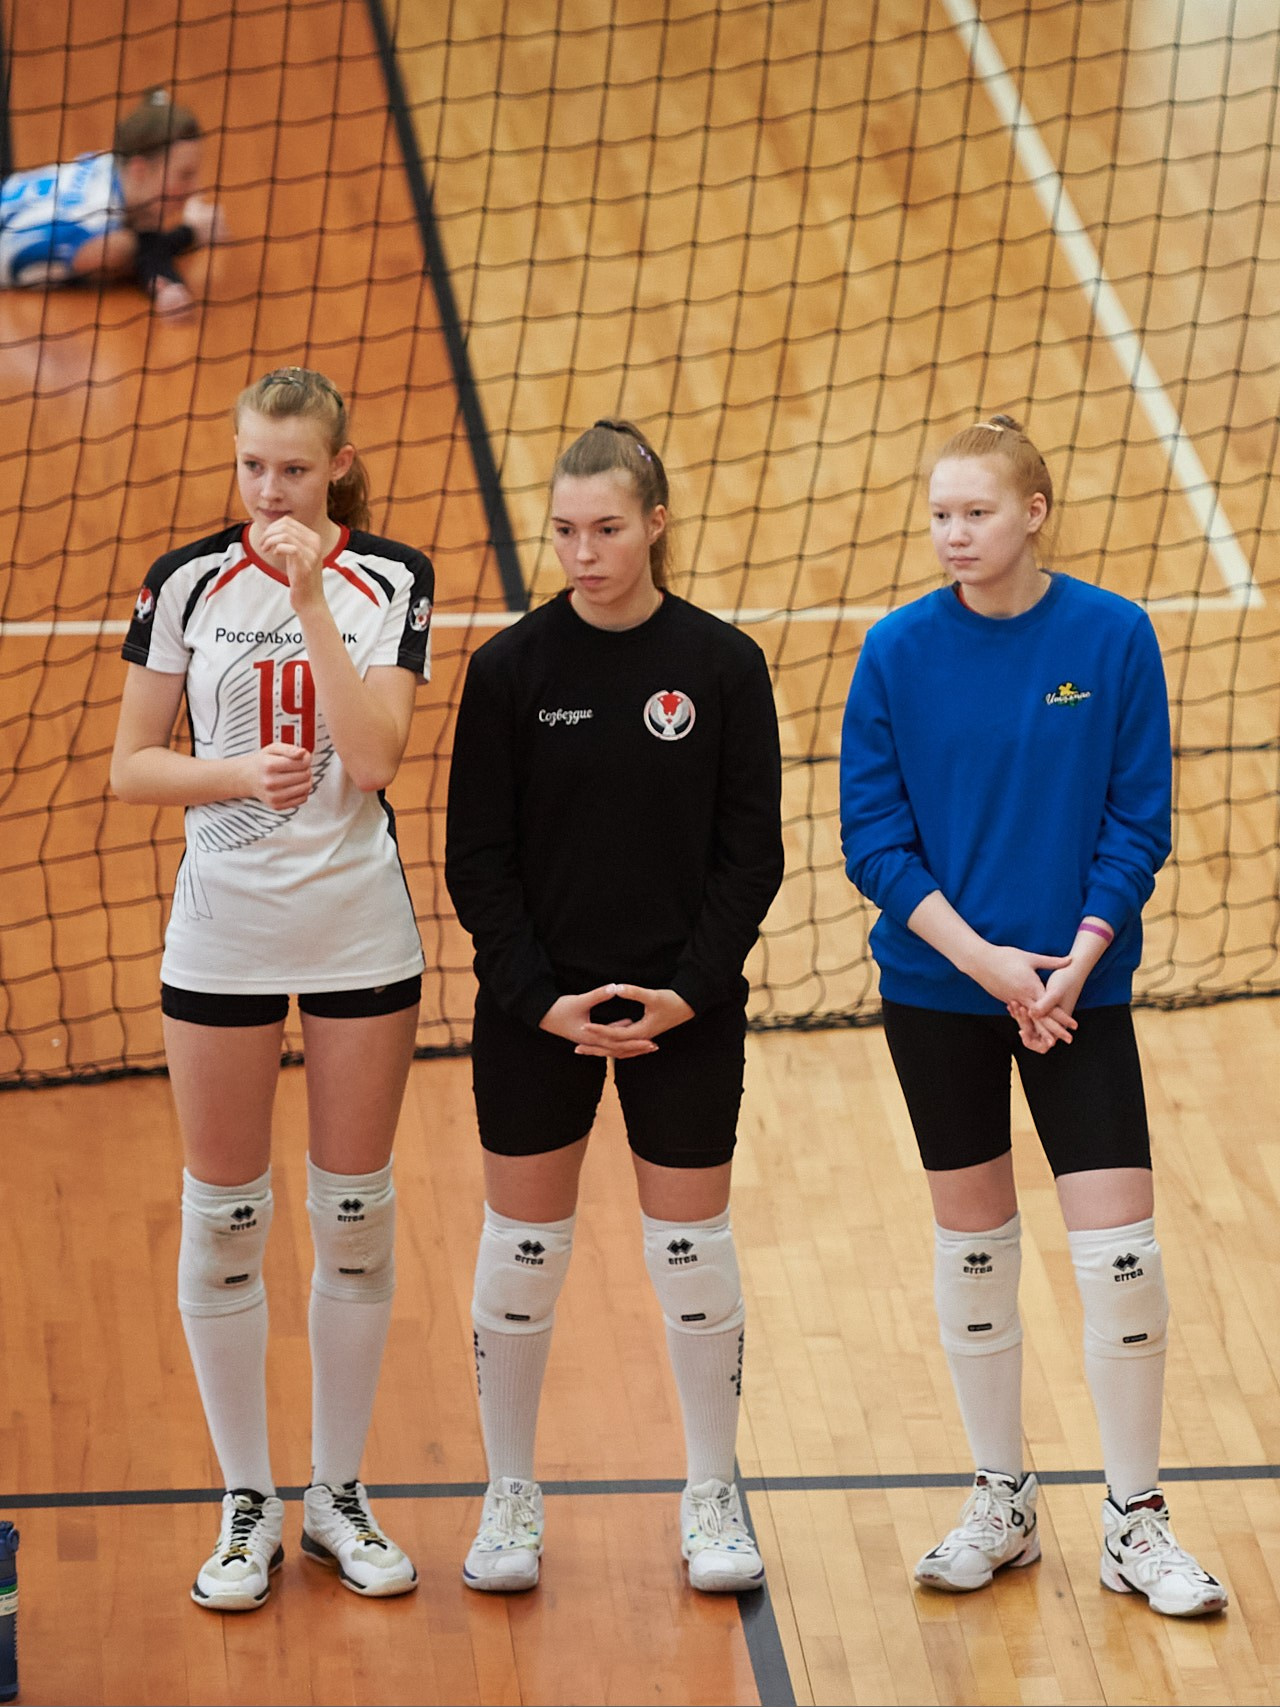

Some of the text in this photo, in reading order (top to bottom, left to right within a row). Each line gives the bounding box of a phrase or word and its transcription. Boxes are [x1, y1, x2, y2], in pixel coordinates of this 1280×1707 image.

[253, 659, 315, 752] 19
[668, 1253, 698, 1266] errea
[963, 1264, 993, 1275] errea
[1114, 1268, 1144, 1283] errea
